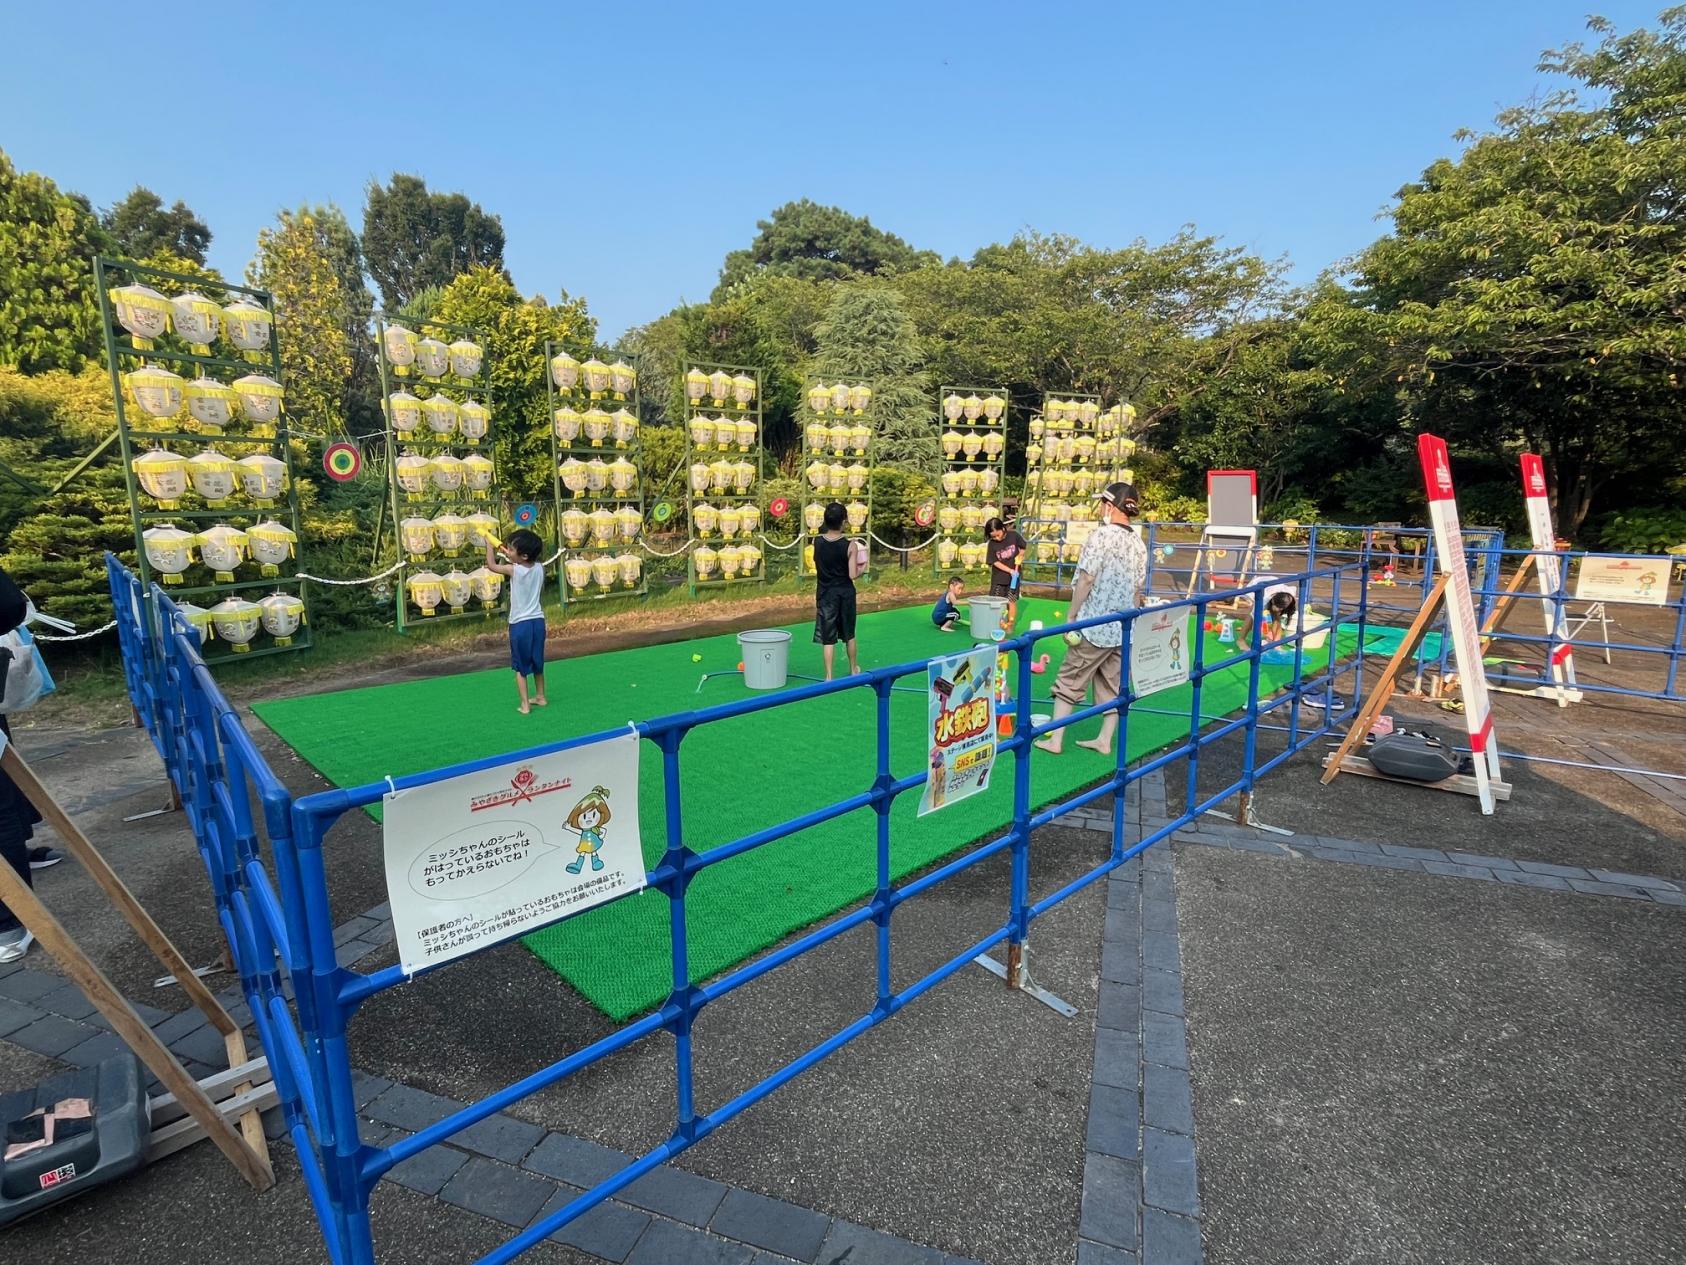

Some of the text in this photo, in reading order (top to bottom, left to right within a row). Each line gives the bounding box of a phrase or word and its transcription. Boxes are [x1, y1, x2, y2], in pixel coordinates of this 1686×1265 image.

[423, 838, 531, 877] がはっているおもちゃは
[428, 829, 525, 864] ミッシちゃんのシール
